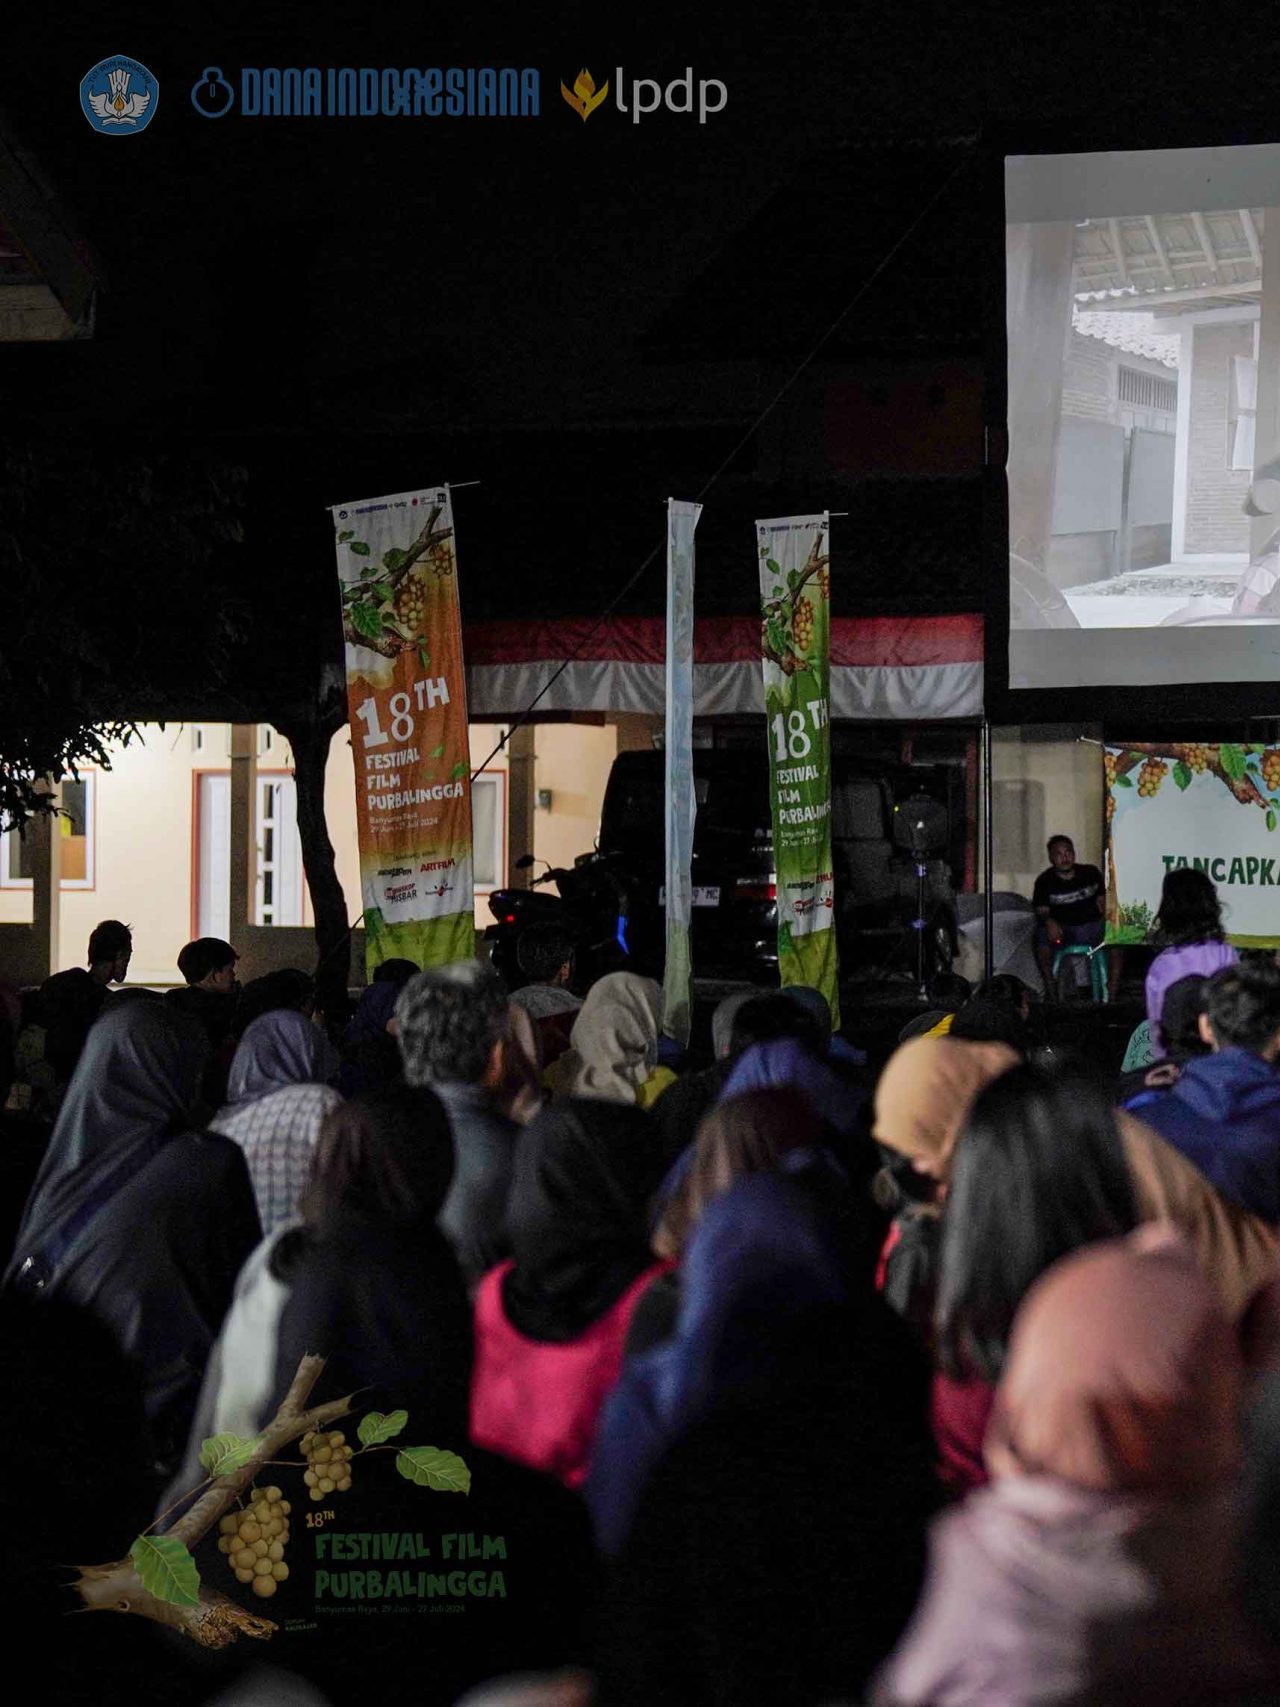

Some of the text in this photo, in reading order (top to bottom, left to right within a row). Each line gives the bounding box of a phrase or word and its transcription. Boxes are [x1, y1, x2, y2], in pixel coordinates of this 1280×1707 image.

[355, 676, 450, 749] 18TH
[366, 747, 420, 770] FESTIVAL
[367, 773, 400, 790] FILM
[367, 781, 464, 811] PURBALINGGA
